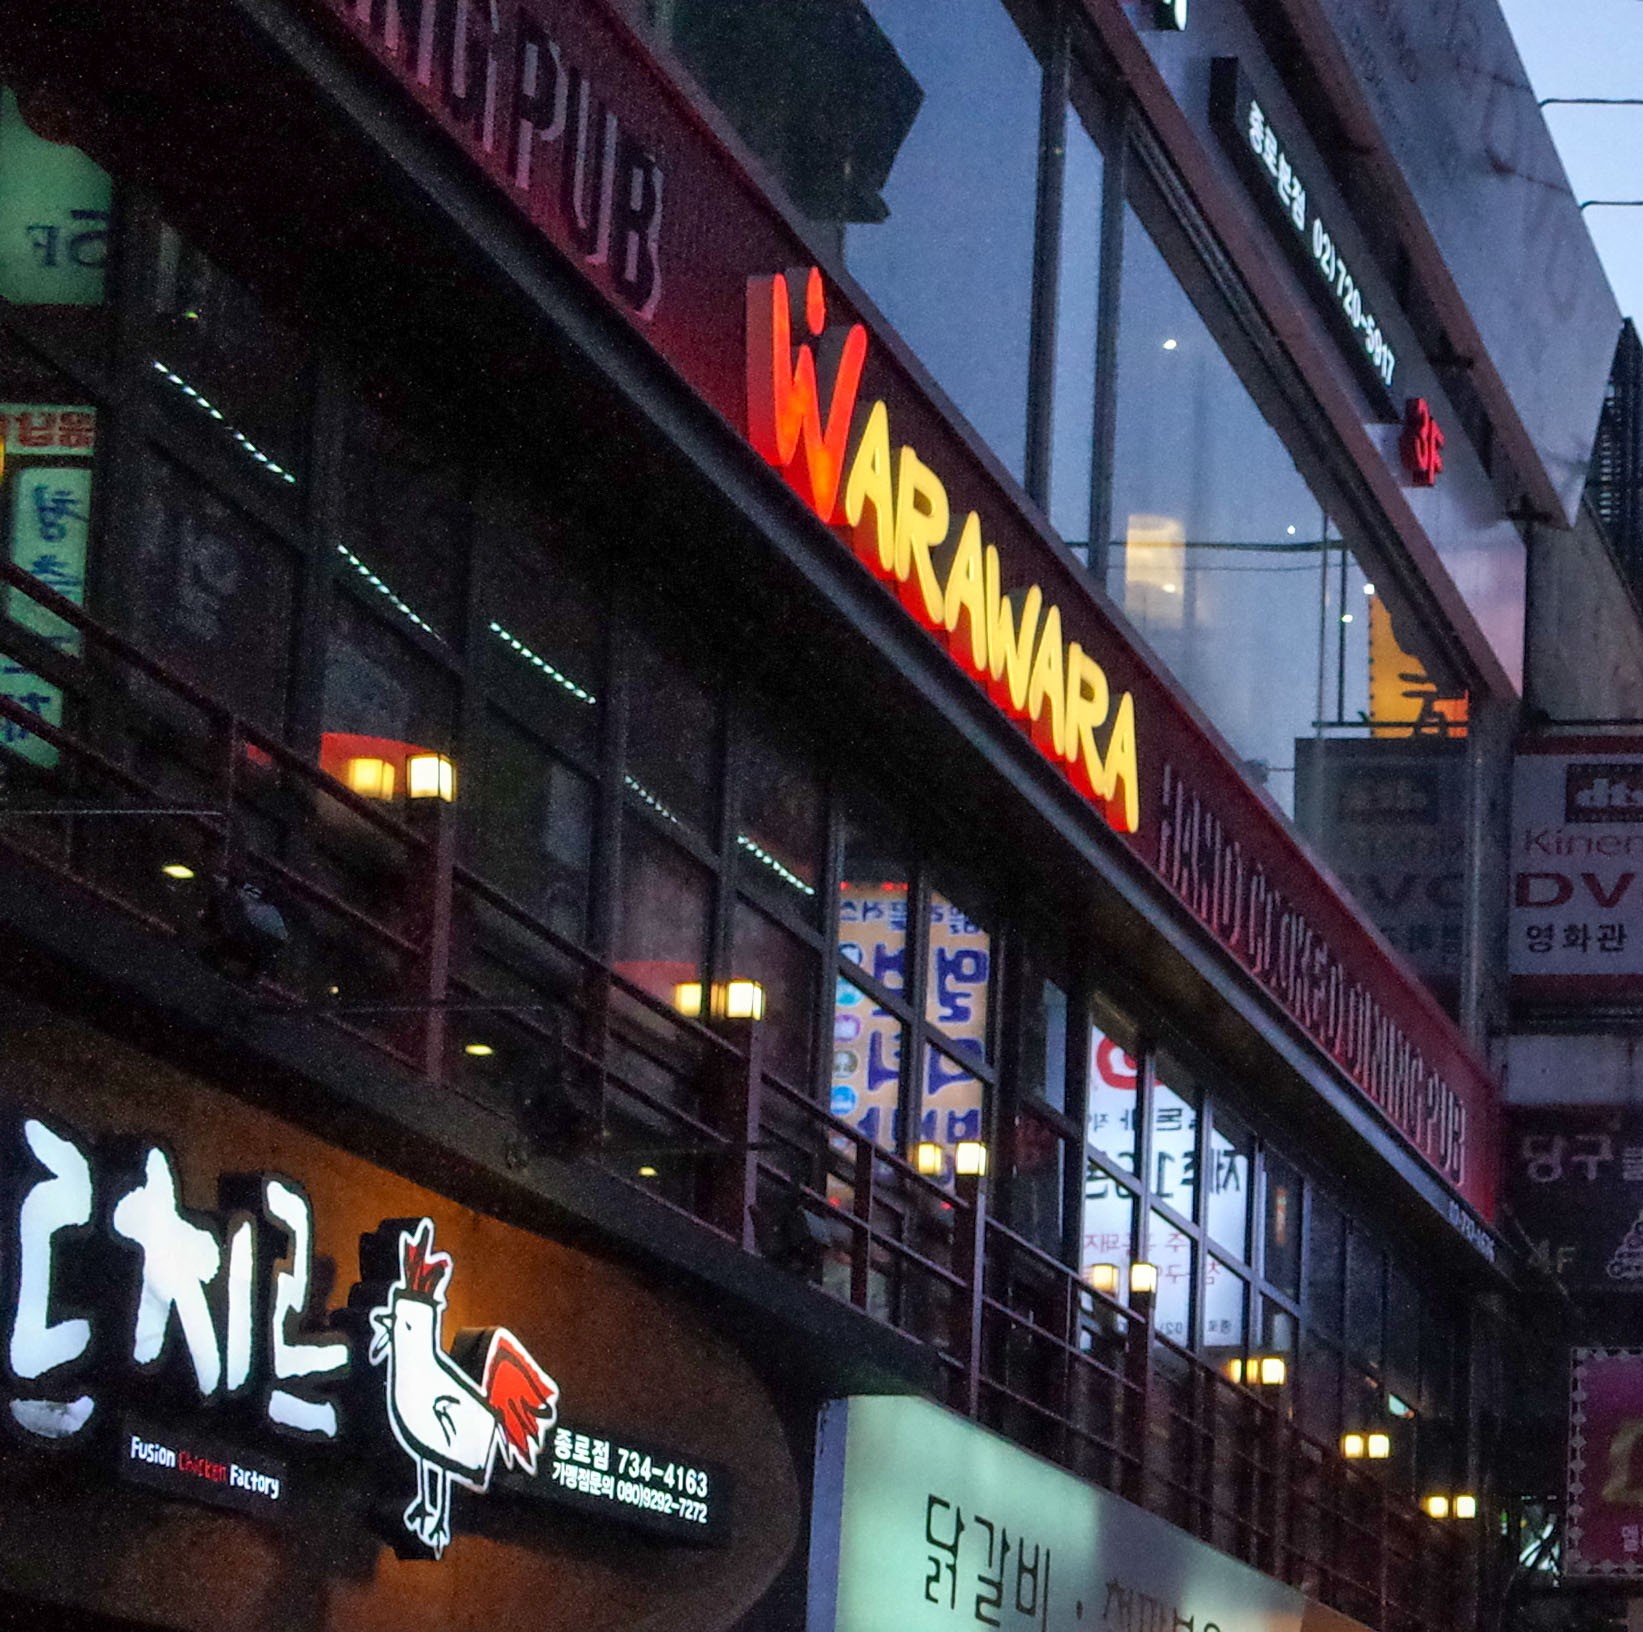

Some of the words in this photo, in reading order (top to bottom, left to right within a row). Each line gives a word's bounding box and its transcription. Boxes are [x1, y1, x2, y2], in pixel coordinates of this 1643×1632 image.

[772, 266, 1140, 834] WARAWARA
[1526, 923, 1628, 953] 영화관
[130, 1435, 176, 1469] Fusion
[229, 1464, 280, 1500] Factory
[554, 1427, 611, 1472] 종로점
[617, 1447, 708, 1498] 734-4163
